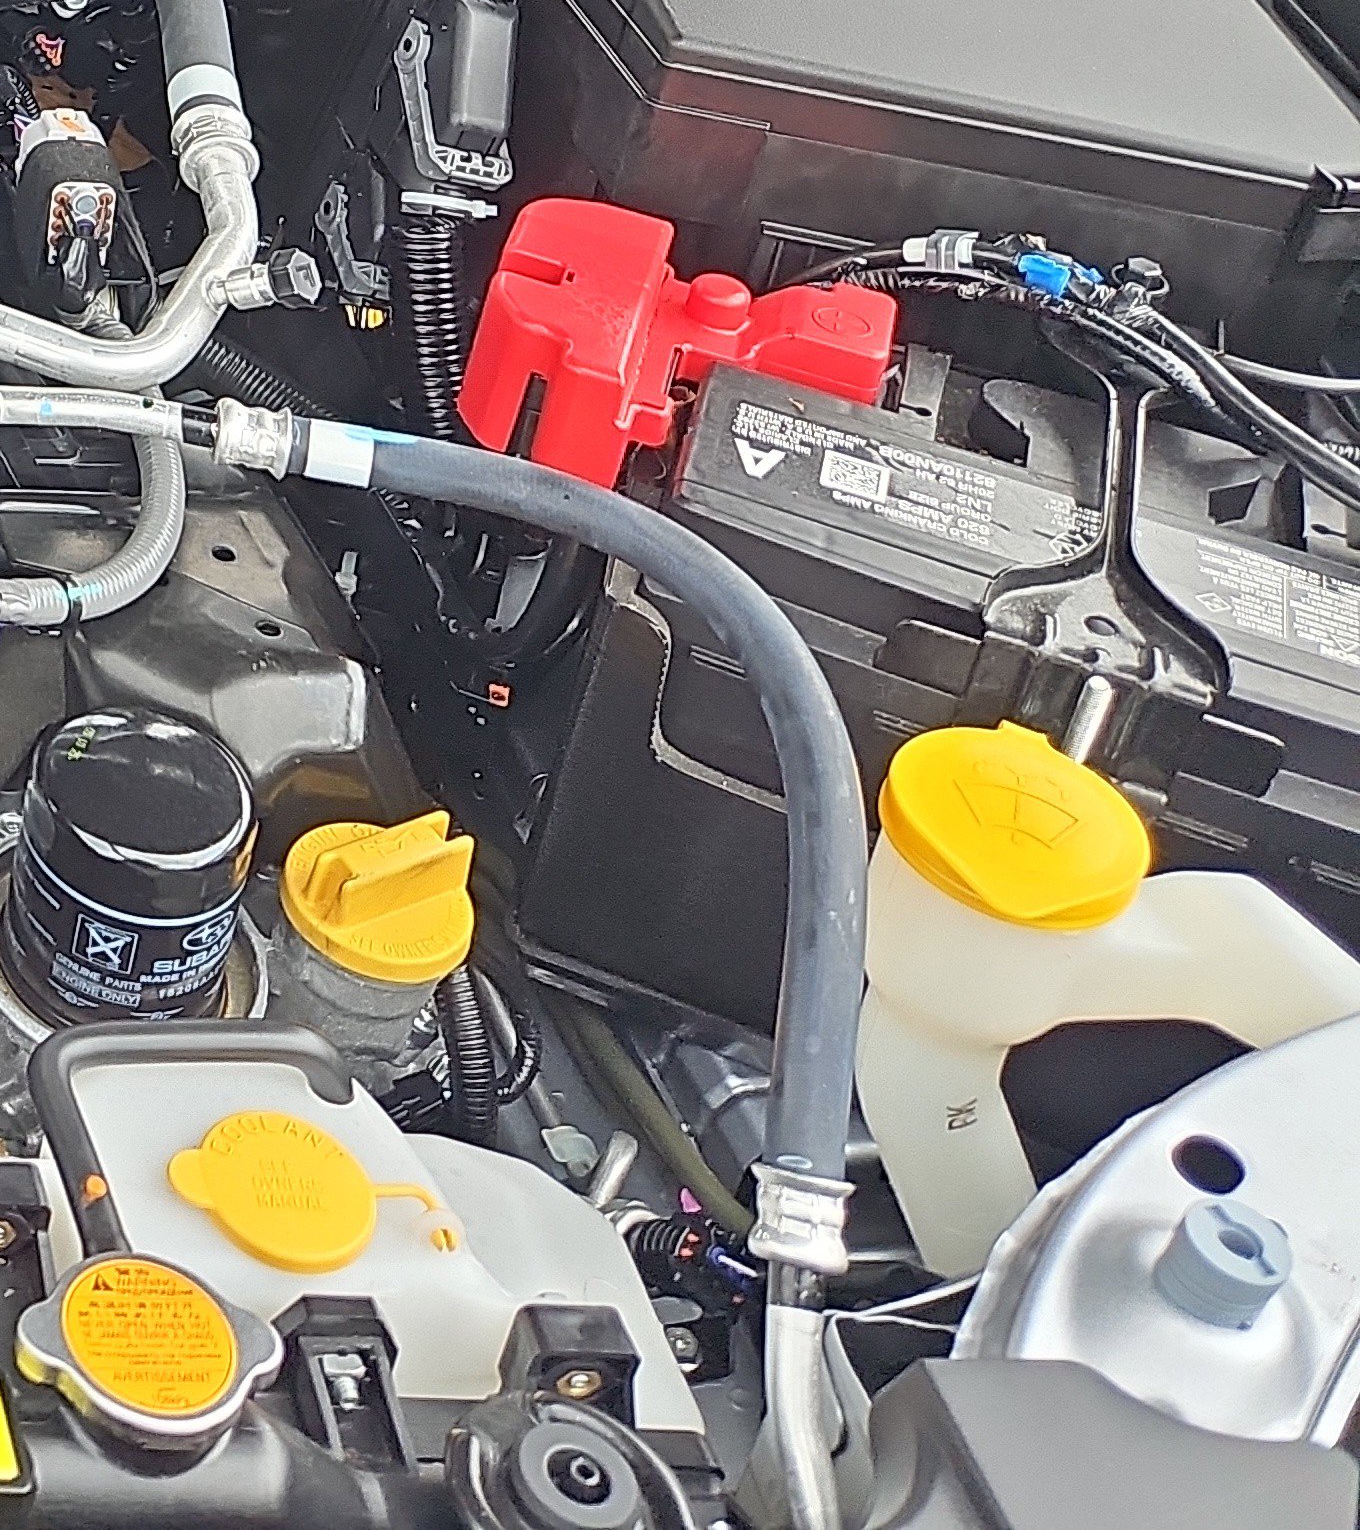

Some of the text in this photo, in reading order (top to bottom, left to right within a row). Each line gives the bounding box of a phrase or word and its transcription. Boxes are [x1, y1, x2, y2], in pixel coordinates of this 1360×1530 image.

[879, 445, 997, 490] 82110AN00B
[915, 468, 937, 482] AH
[940, 501, 992, 523] GROUP
[956, 492, 993, 514] LN2
[832, 490, 989, 546] COLD CRANKING AMPS
[898, 499, 991, 536] 620 AMPS
[104, 976, 143, 991] PARTS
[139, 972, 180, 984] MADE
[101, 990, 138, 1005] ONLY
[210, 1115, 345, 1159] COOLANT
